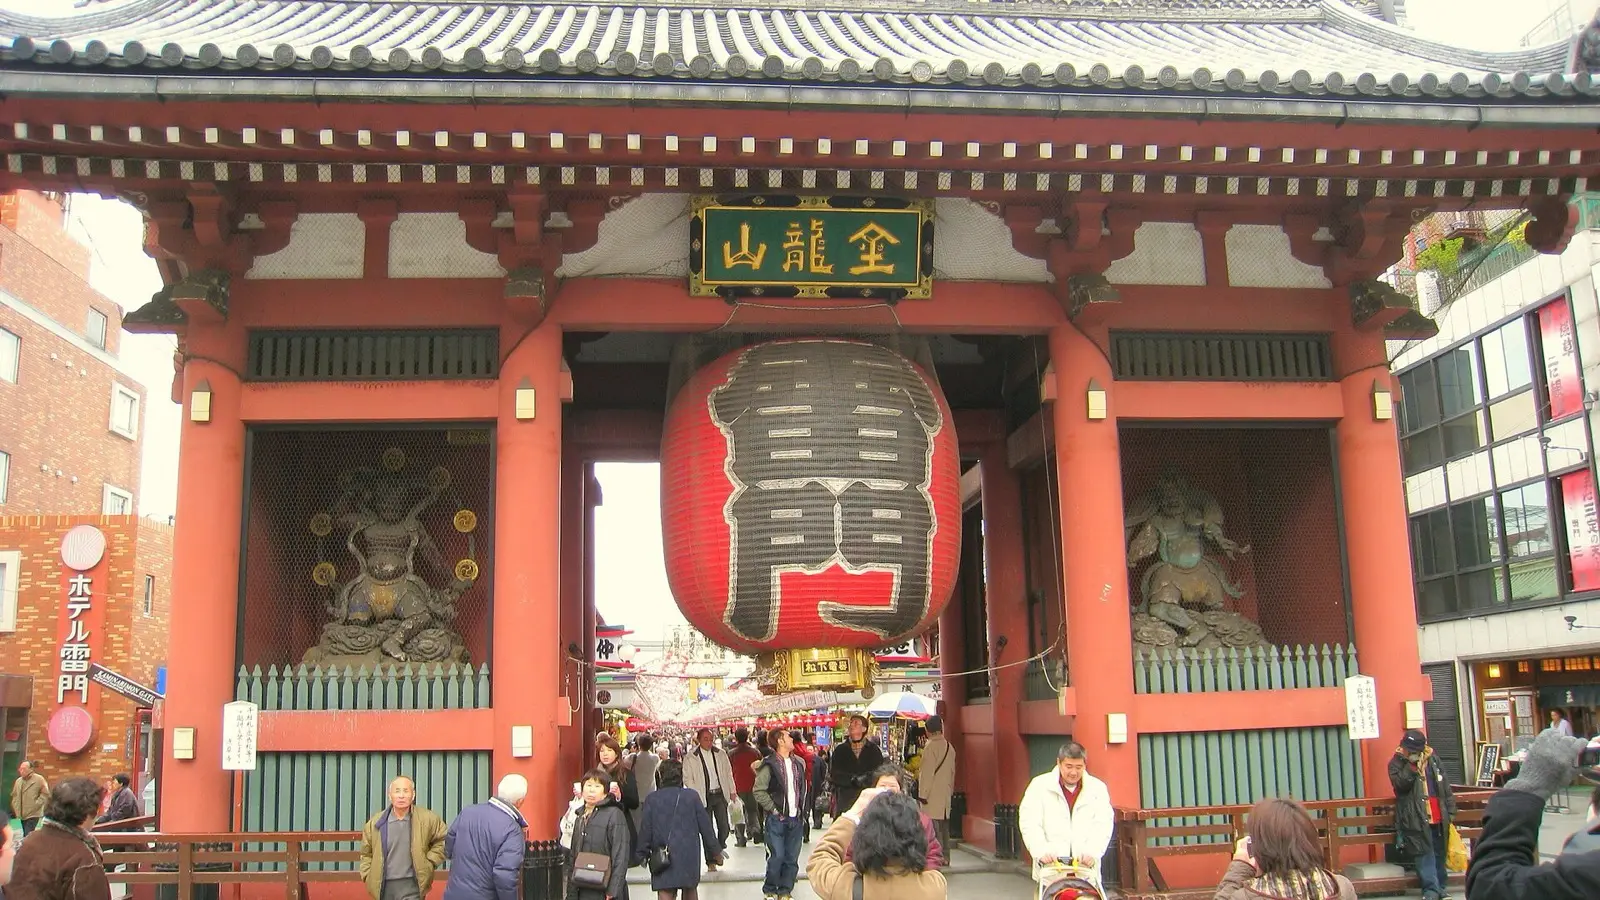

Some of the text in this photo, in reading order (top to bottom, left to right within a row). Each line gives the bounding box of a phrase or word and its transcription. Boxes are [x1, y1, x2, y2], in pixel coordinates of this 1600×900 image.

[722, 217, 900, 275] 金龍山
[706, 339, 943, 643] 雷門
[57, 574, 92, 704] ホテル雷門
[804, 660, 848, 673] 松下電器
[97, 670, 141, 694] KAMINARIMON
[138, 690, 156, 701] GATE
